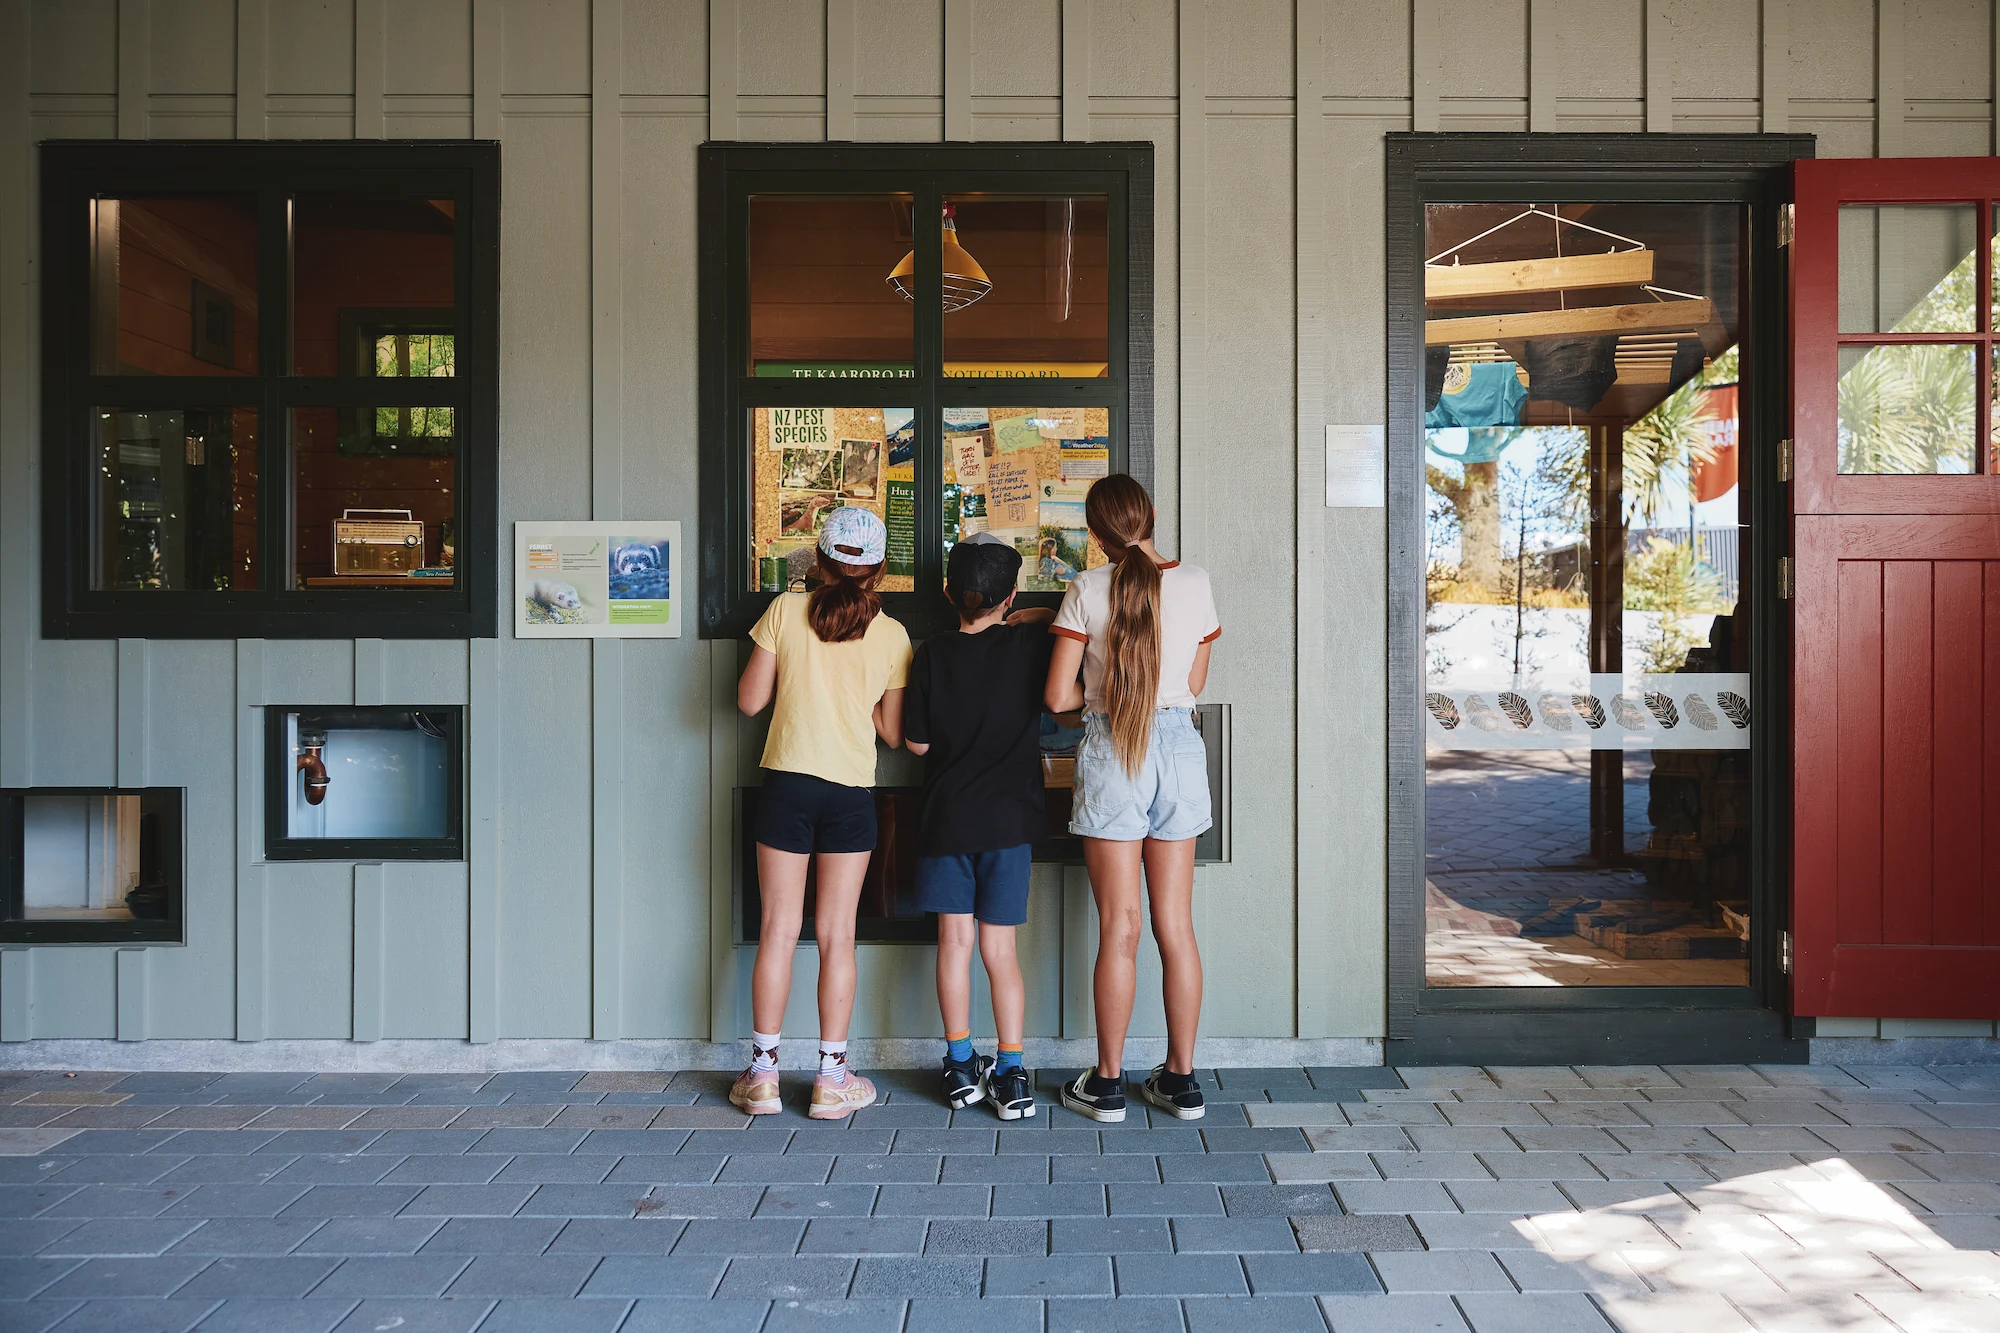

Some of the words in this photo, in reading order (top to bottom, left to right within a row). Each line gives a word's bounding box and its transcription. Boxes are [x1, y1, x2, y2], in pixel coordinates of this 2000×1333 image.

[793, 370, 812, 379] TE
[817, 369, 894, 379] KAARORO
[943, 370, 1060, 379] NOTICEBOARD
[775, 409, 791, 426] NZ
[795, 408, 825, 426] PEST
[775, 426, 828, 444] SPECIES
[891, 486, 909, 496] Hut
